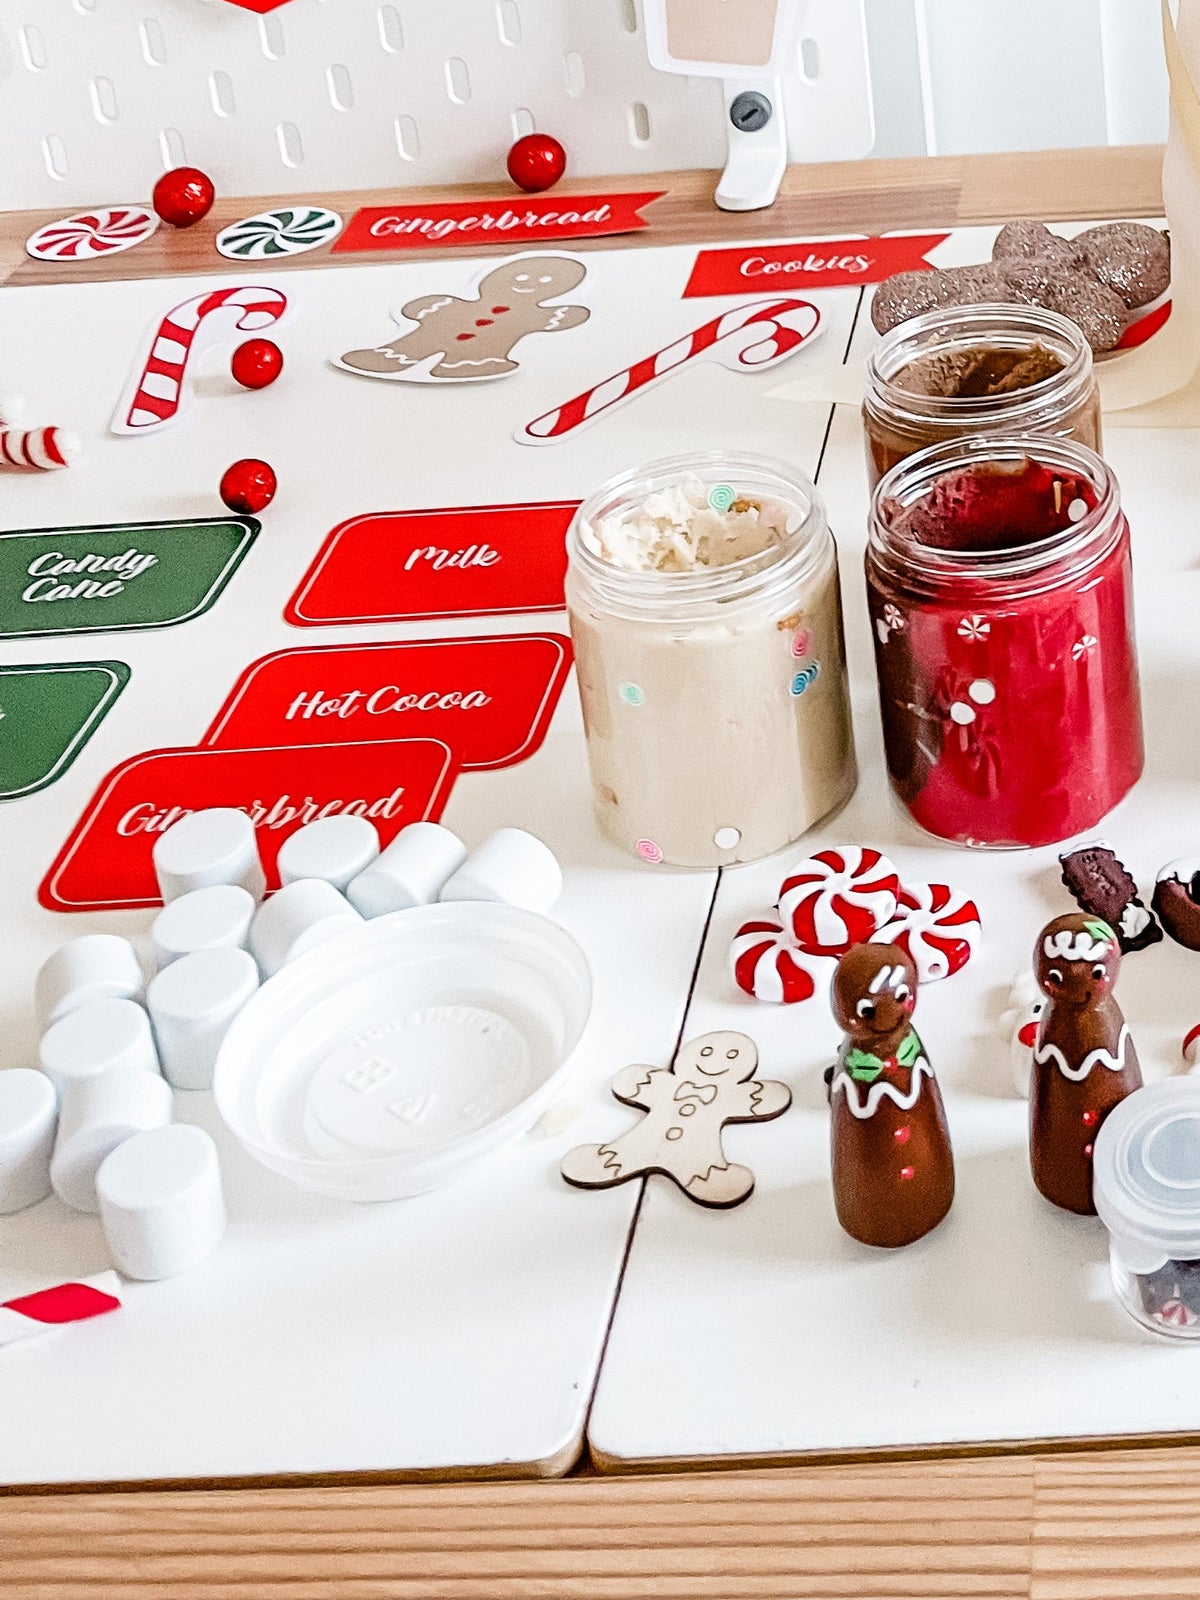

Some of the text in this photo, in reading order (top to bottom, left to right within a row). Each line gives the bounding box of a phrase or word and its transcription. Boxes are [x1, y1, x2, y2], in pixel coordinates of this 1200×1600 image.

[370, 204, 611, 238] Gingerbread
[740, 252, 876, 278] Cookies
[27, 549, 159, 580] Candy
[404, 544, 502, 571] Milk
[22, 576, 124, 603] Cane
[285, 685, 493, 720] Hot Cocoa
